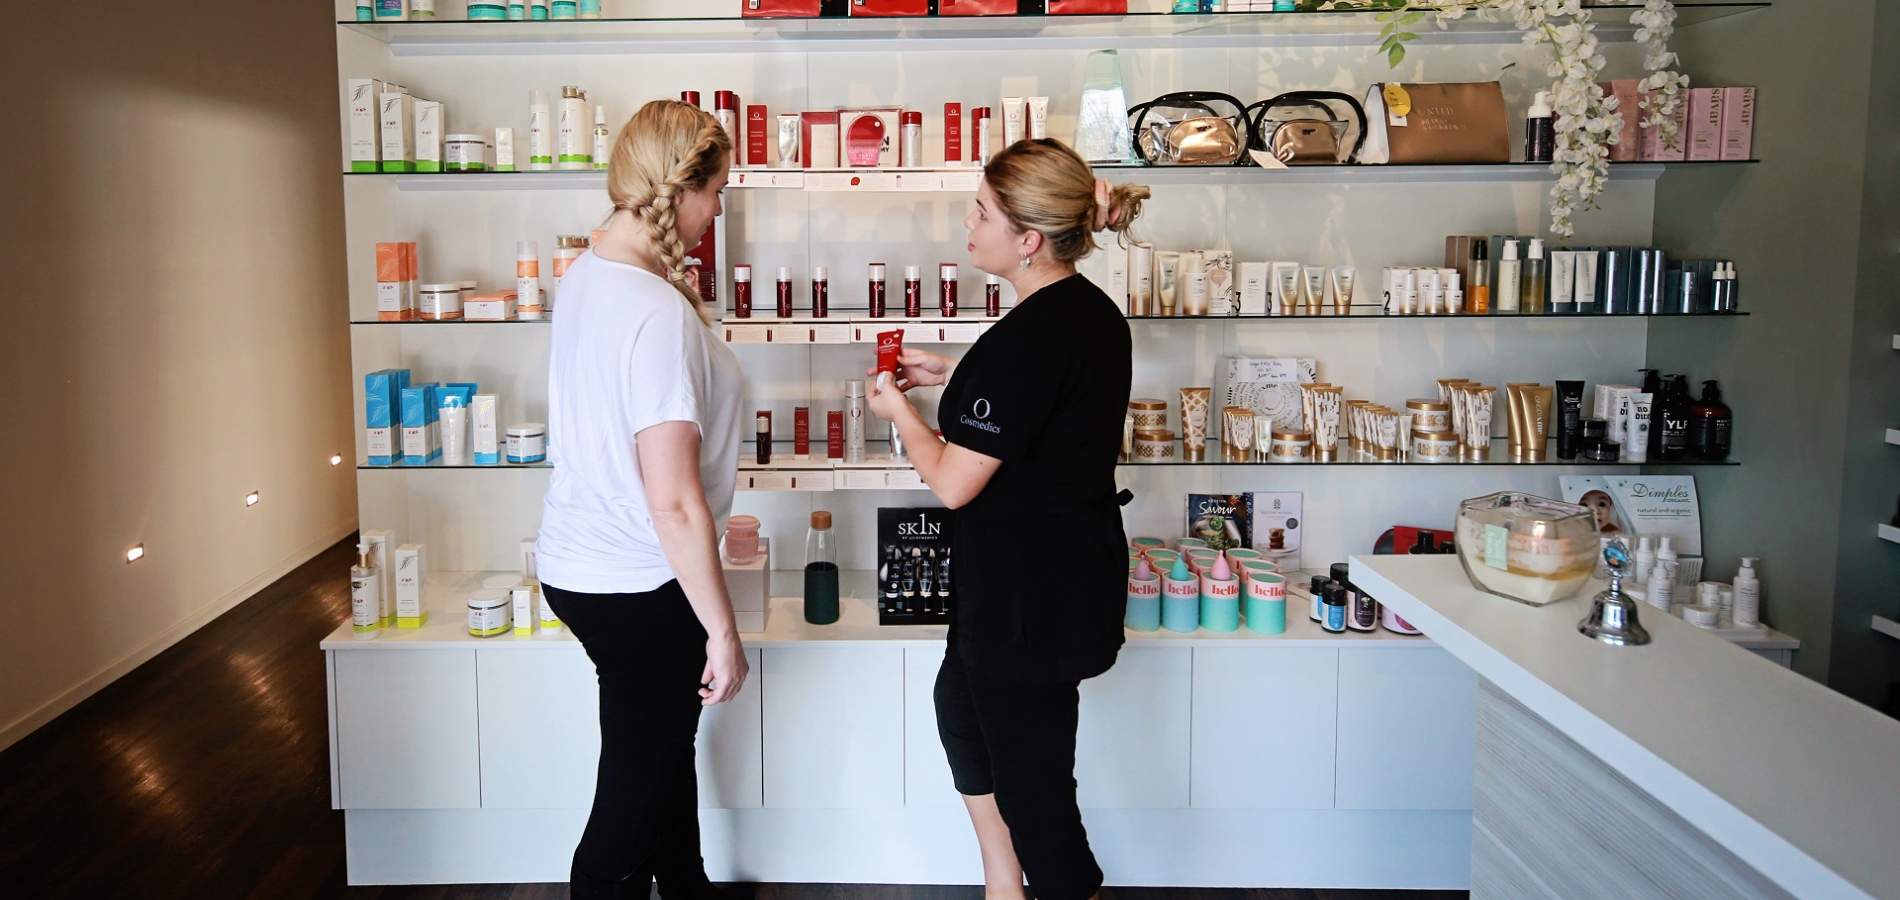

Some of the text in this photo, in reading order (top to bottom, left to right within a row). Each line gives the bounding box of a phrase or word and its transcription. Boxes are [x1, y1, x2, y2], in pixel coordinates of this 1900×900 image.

[1383, 290, 1391, 311] 2
[973, 398, 991, 420] O
[960, 414, 1001, 434] Cosmedics
[1631, 483, 1689, 502] Dimples
[1200, 501, 1237, 516] Savour
